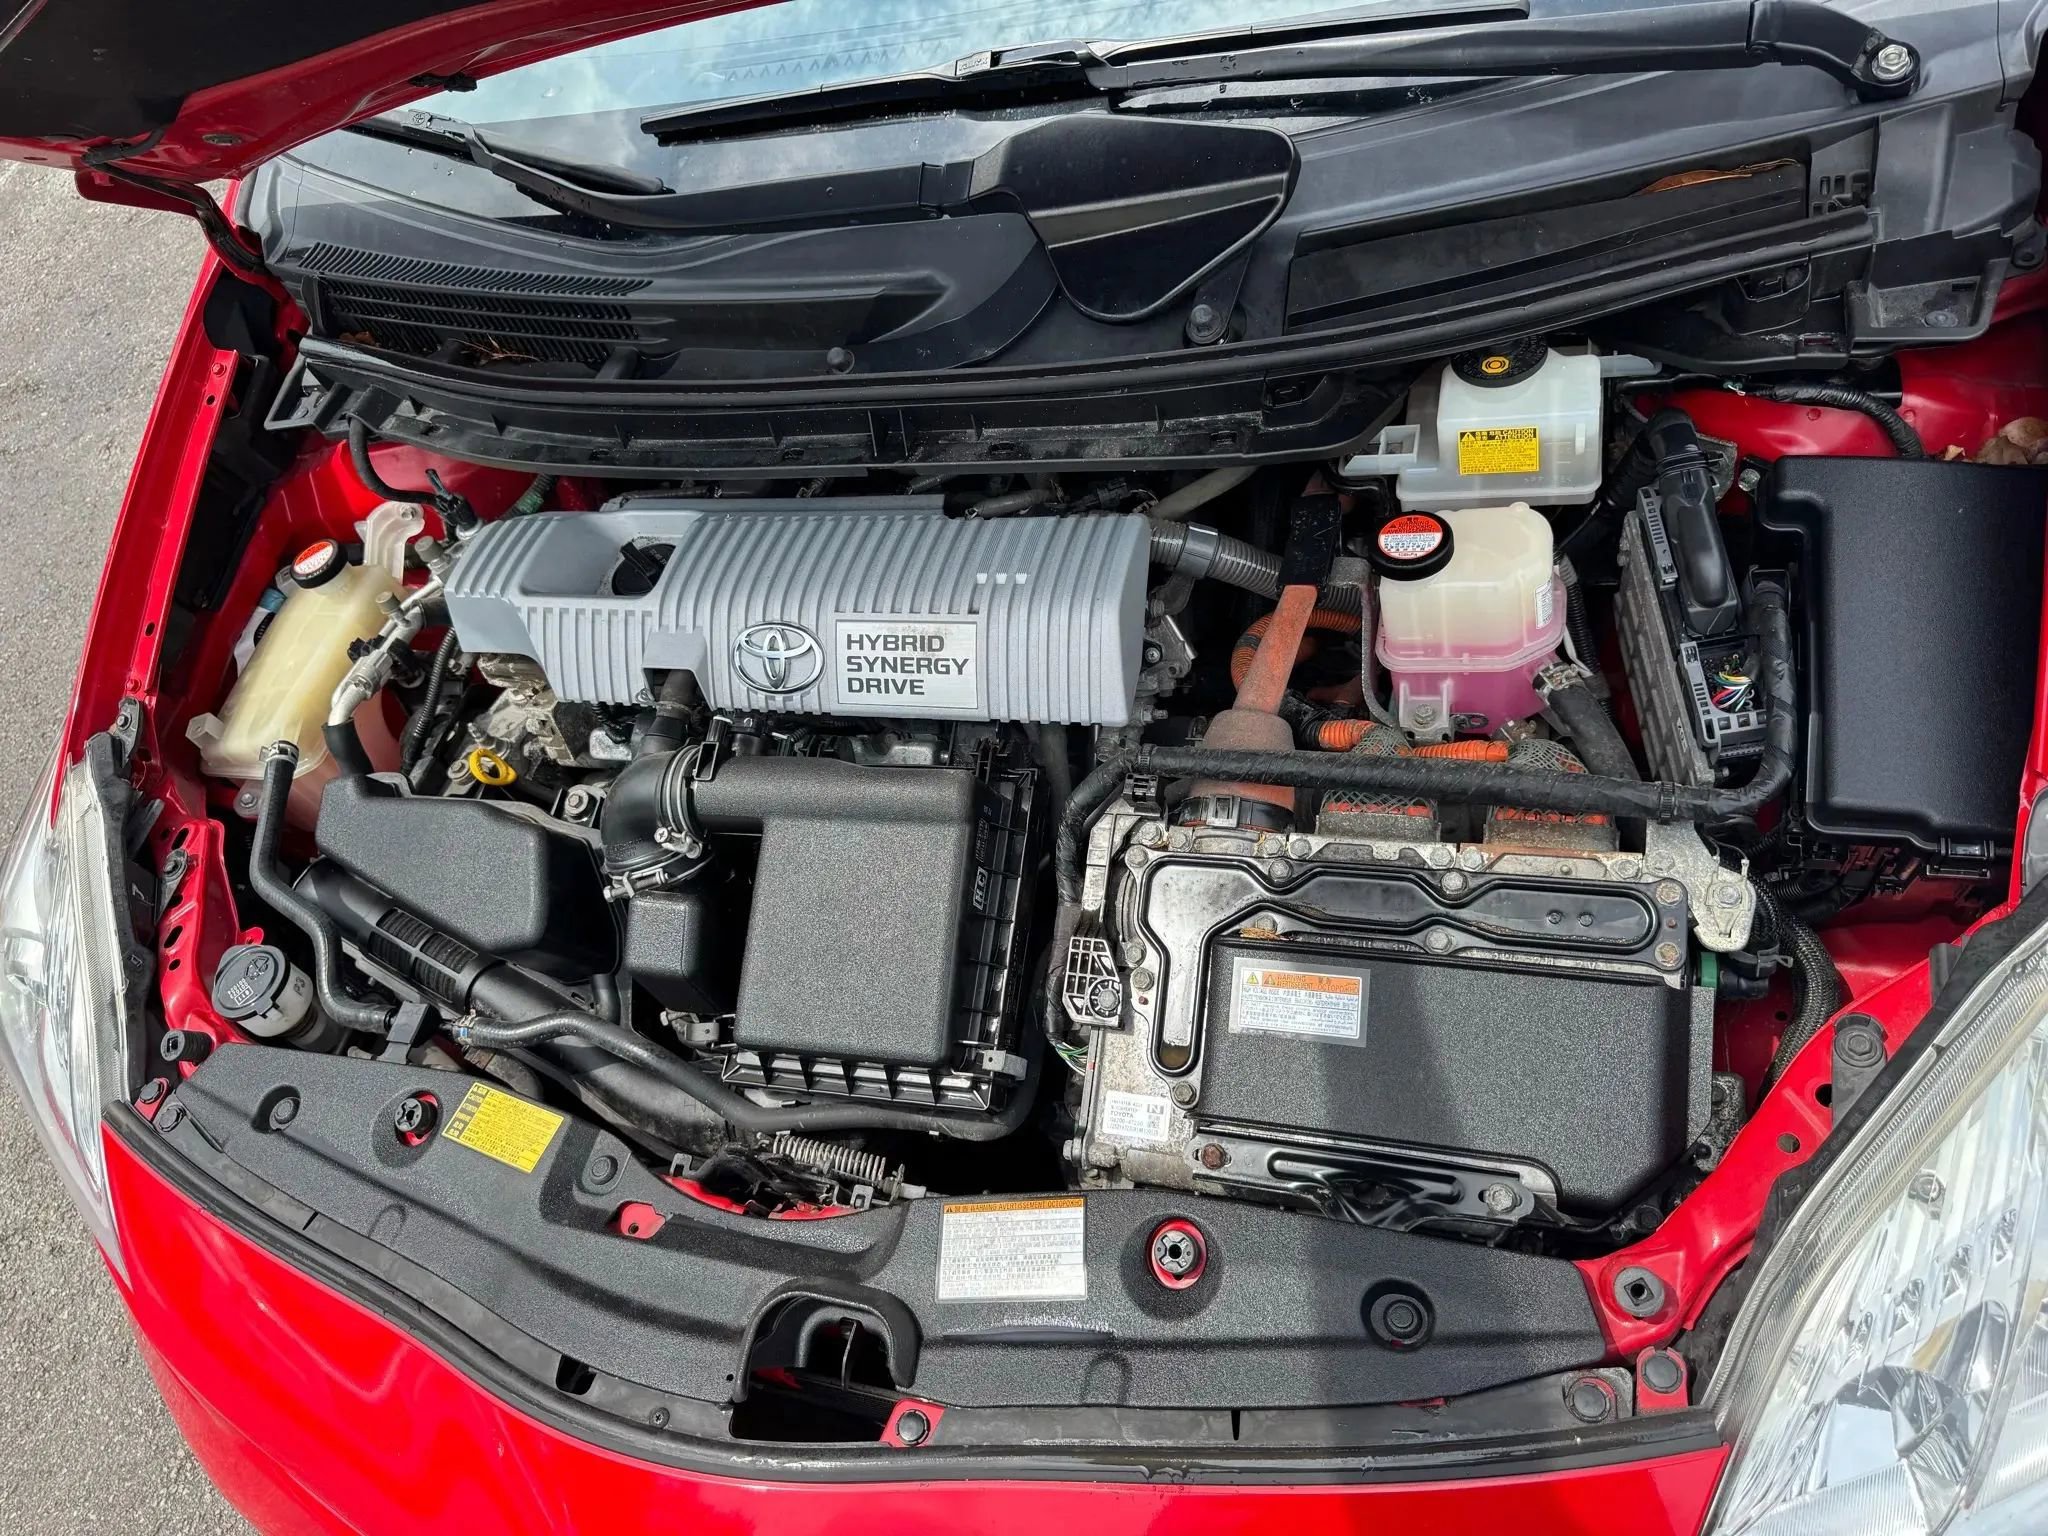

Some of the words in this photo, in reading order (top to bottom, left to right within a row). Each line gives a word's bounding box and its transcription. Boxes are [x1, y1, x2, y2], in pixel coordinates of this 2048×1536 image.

[1494, 433, 1534, 441] ATTENTION
[1502, 428, 1534, 436] CAUTION
[846, 633, 945, 652] HYBRID
[846, 655, 969, 676] SYNERGY
[847, 677, 925, 695] DRIVE
[1276, 973, 1306, 982] WARNING
[1110, 1110, 1134, 1119] TOYOTA
[970, 1203, 998, 1213] WARNING
[998, 1201, 1046, 1211] AVERTISSEMENT
